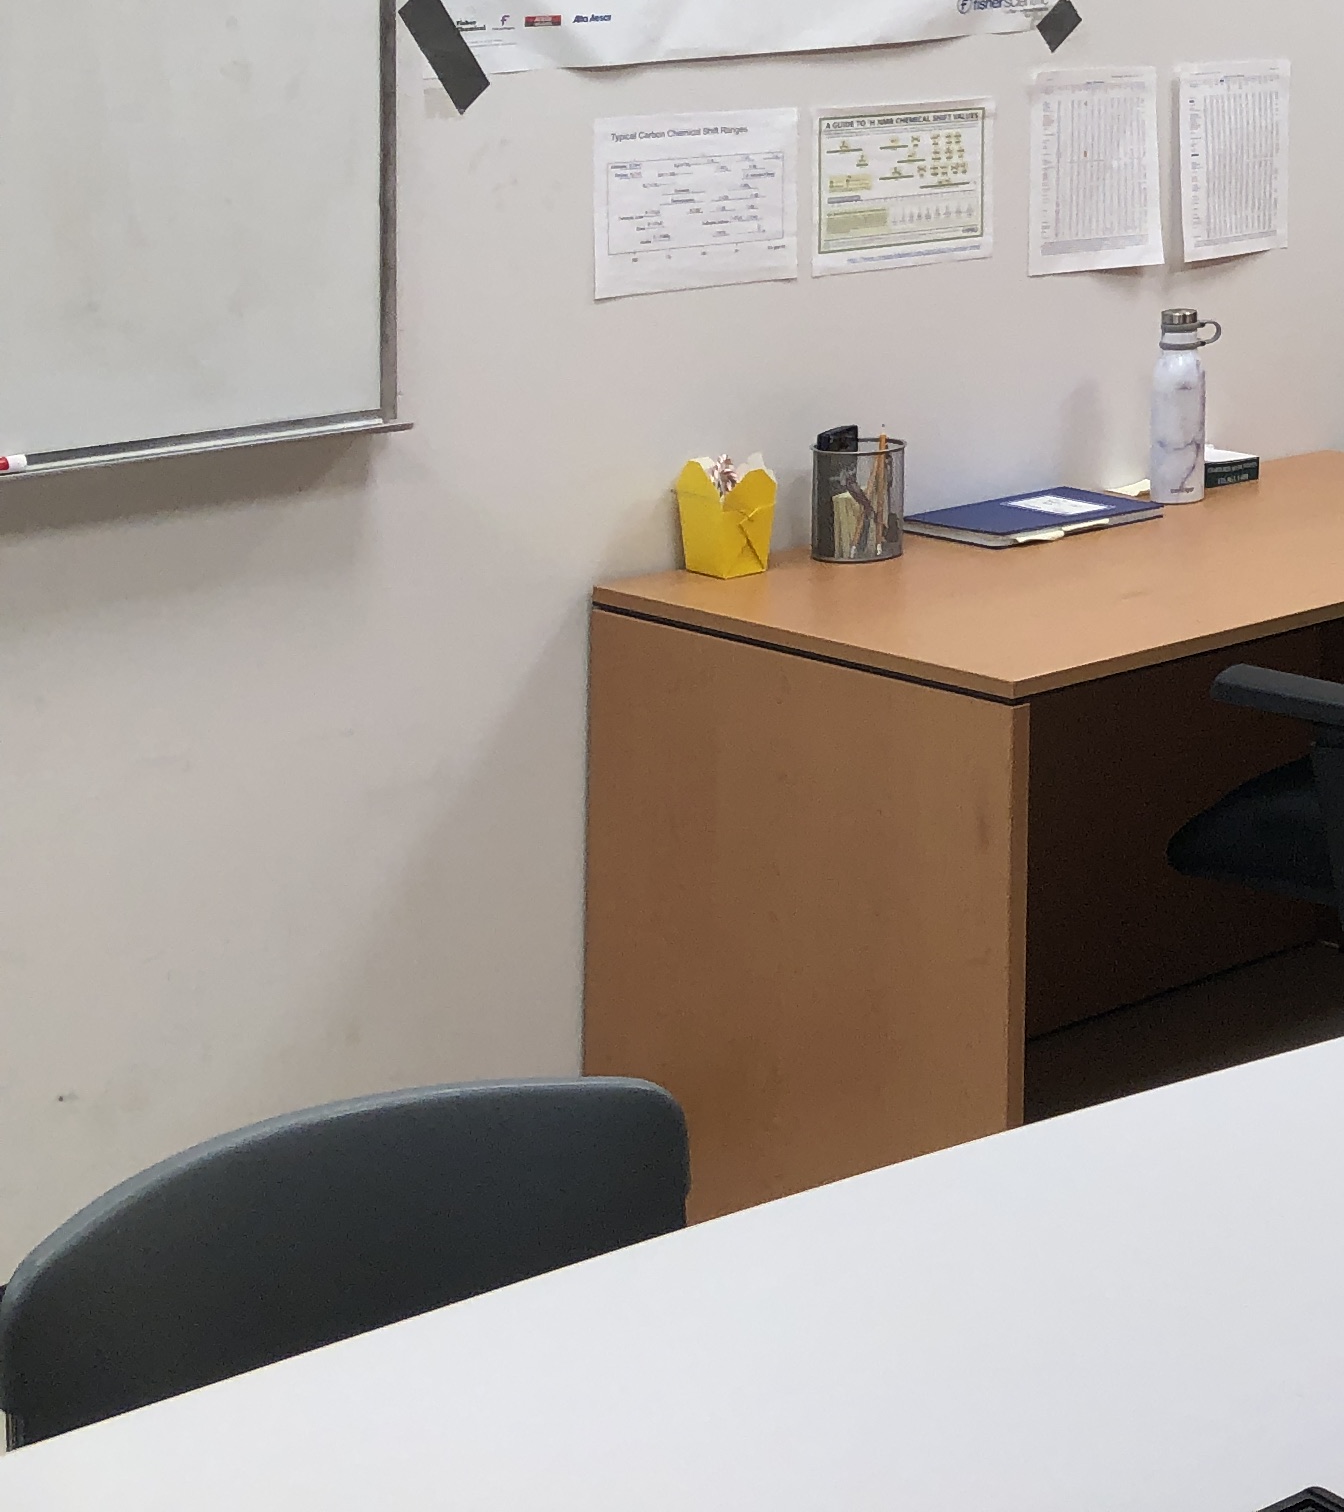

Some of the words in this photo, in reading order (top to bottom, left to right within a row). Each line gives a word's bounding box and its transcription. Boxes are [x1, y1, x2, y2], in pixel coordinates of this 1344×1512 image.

[896, 116, 930, 124] CHEMICAL
[611, 132, 636, 142] Typical
[639, 131, 665, 139] Carbon
[667, 129, 700, 137] Chemical
[721, 126, 748, 134] Ranges
